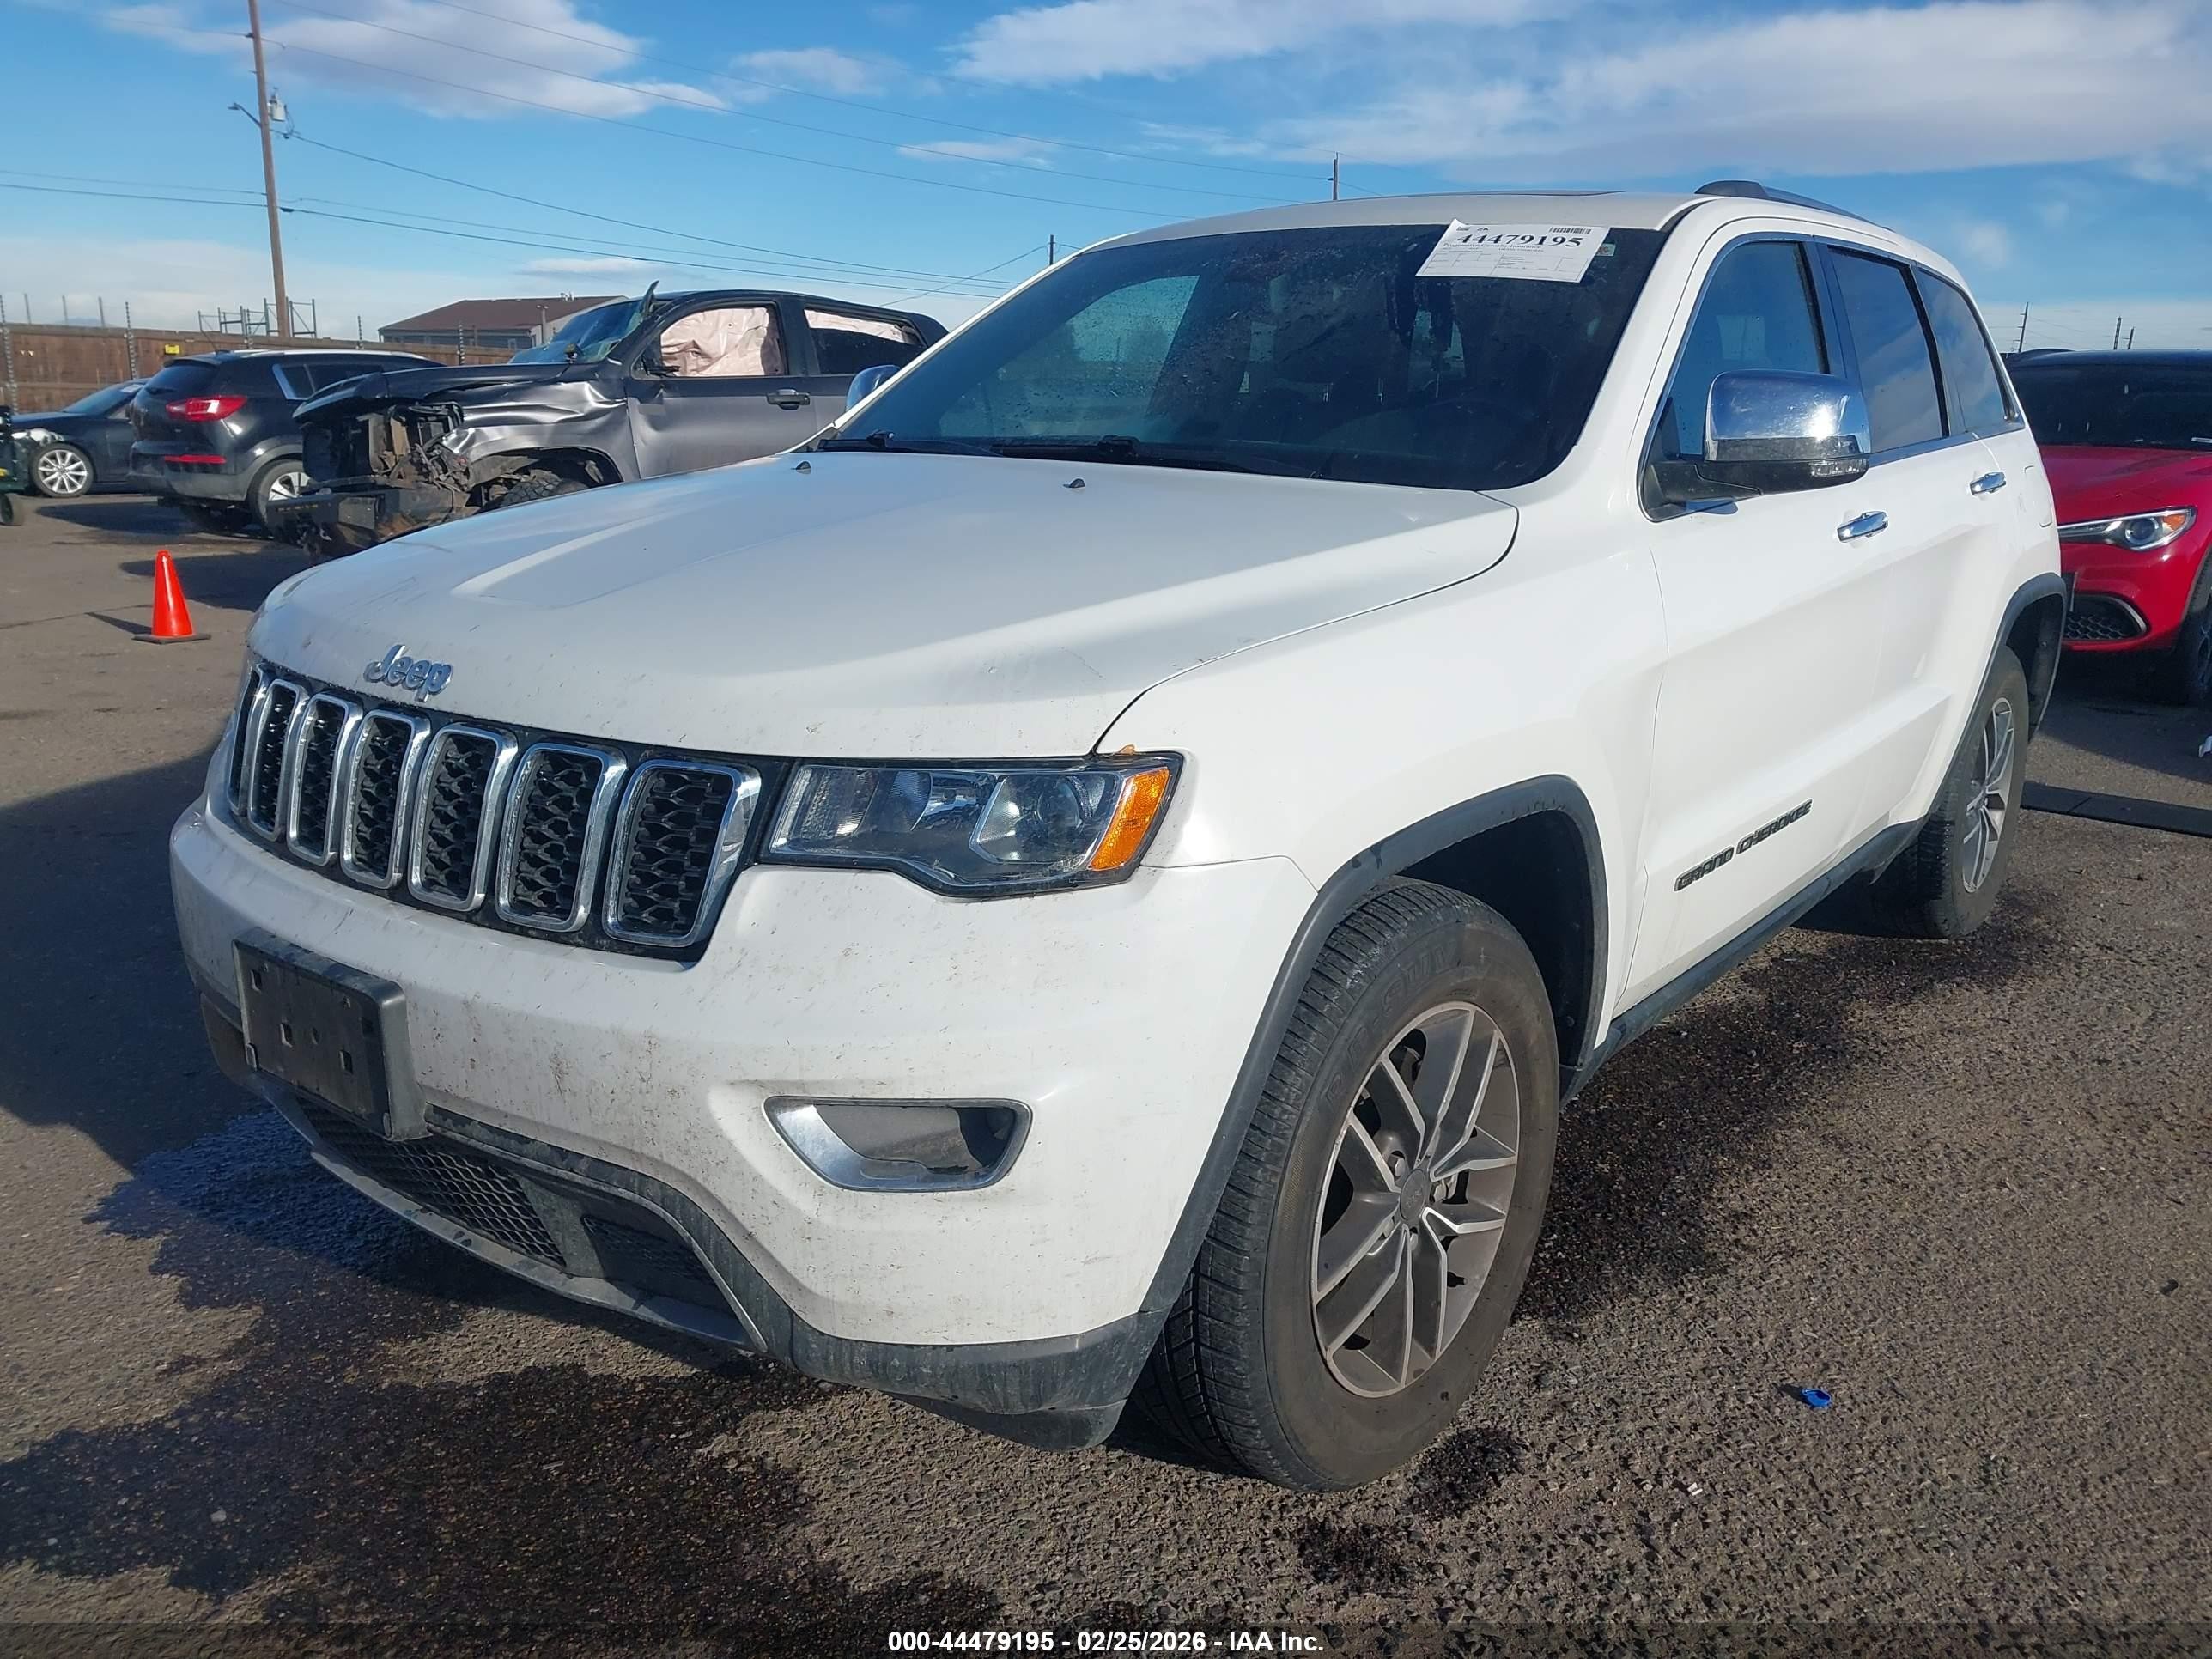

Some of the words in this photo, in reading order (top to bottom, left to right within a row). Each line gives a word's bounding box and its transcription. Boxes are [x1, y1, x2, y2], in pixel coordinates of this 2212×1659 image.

[1456, 234, 1583, 247] 44479195
[363, 644, 453, 702] Jeep
[1674, 846, 1735, 891] GRAND
[1735, 799, 1813, 854] CHEROKEE
